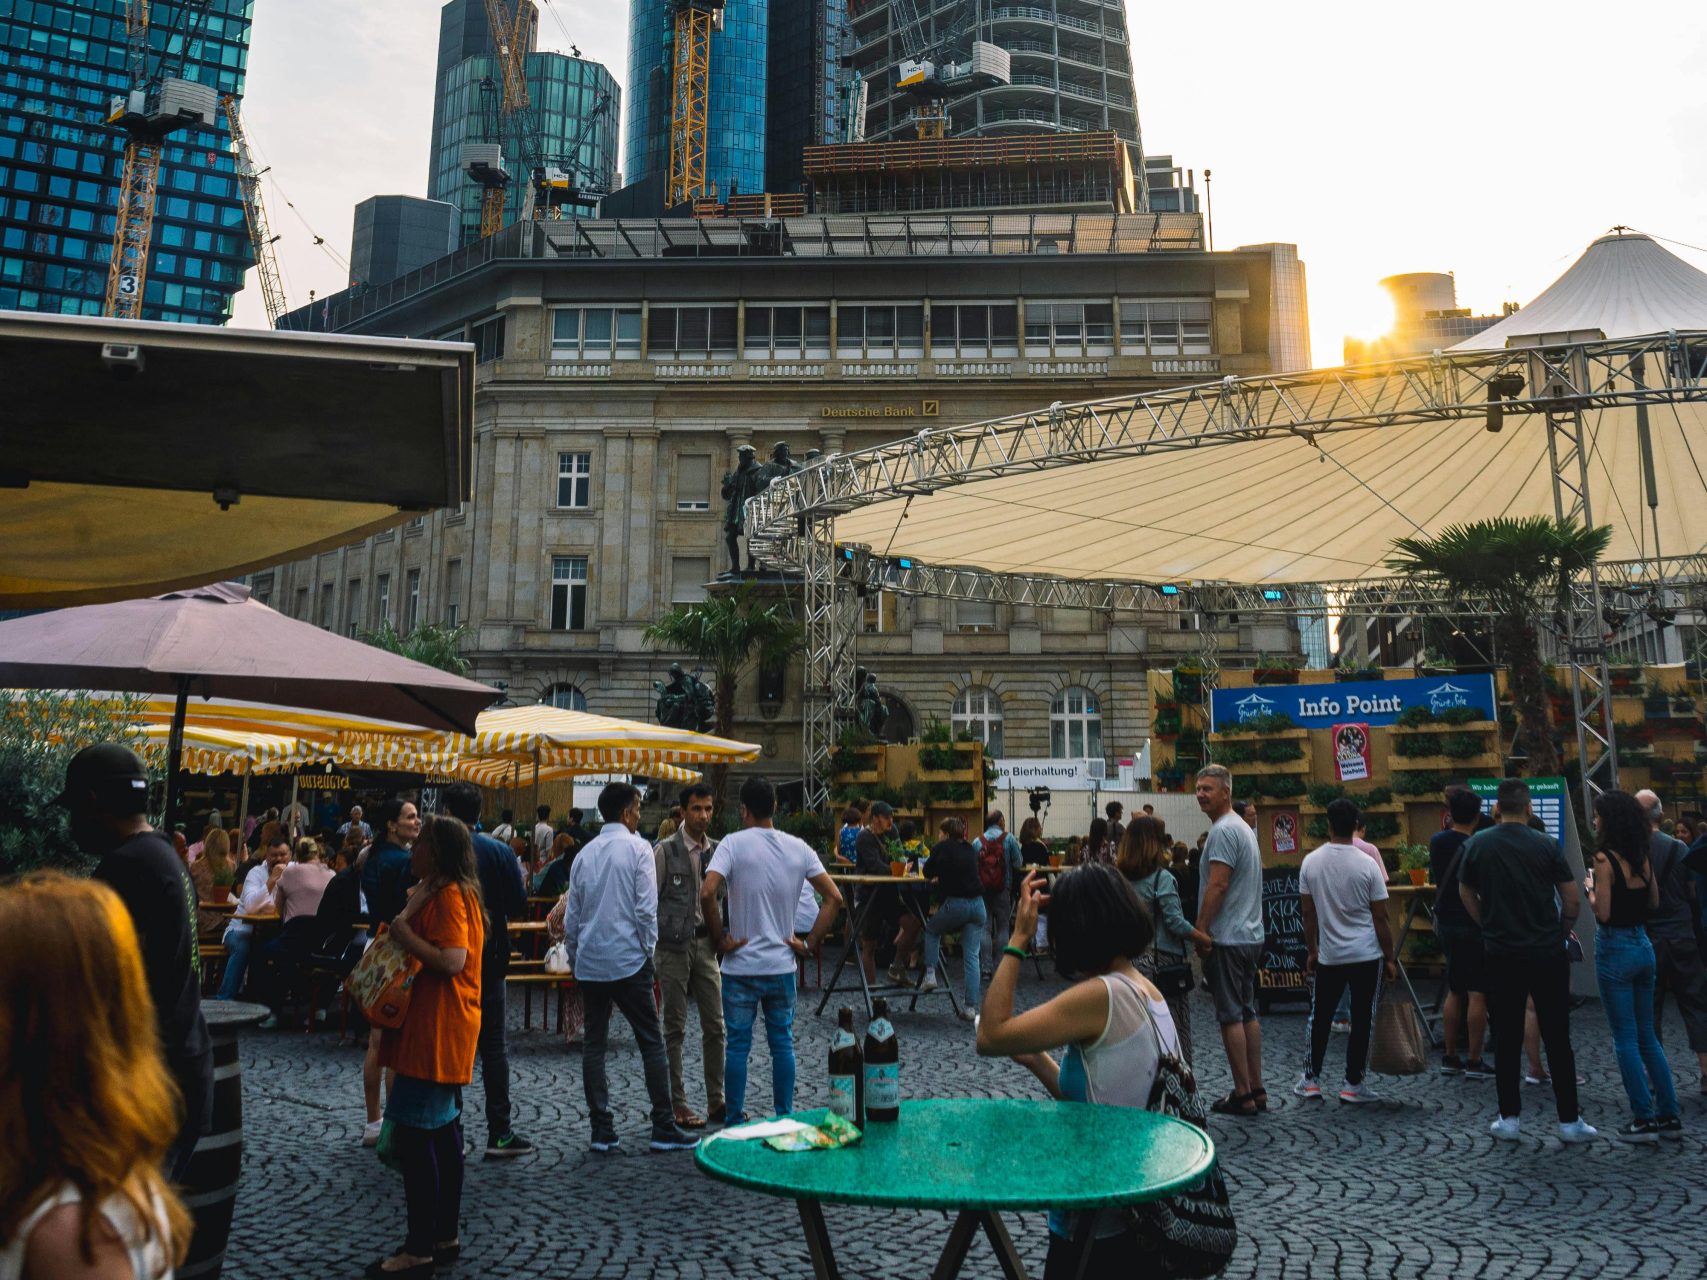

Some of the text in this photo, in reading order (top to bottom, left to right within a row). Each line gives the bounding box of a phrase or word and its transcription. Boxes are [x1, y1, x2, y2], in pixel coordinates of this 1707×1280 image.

[121, 276, 135, 293] 3
[821, 406, 915, 417] Deutsche Bank
[1298, 694, 1401, 717] Info Point
[1012, 765, 1078, 778] Bierhaltung!
[1483, 783, 1499, 791] habe
[1268, 899, 1301, 919] KICK
[1282, 916, 1305, 934] LUN
